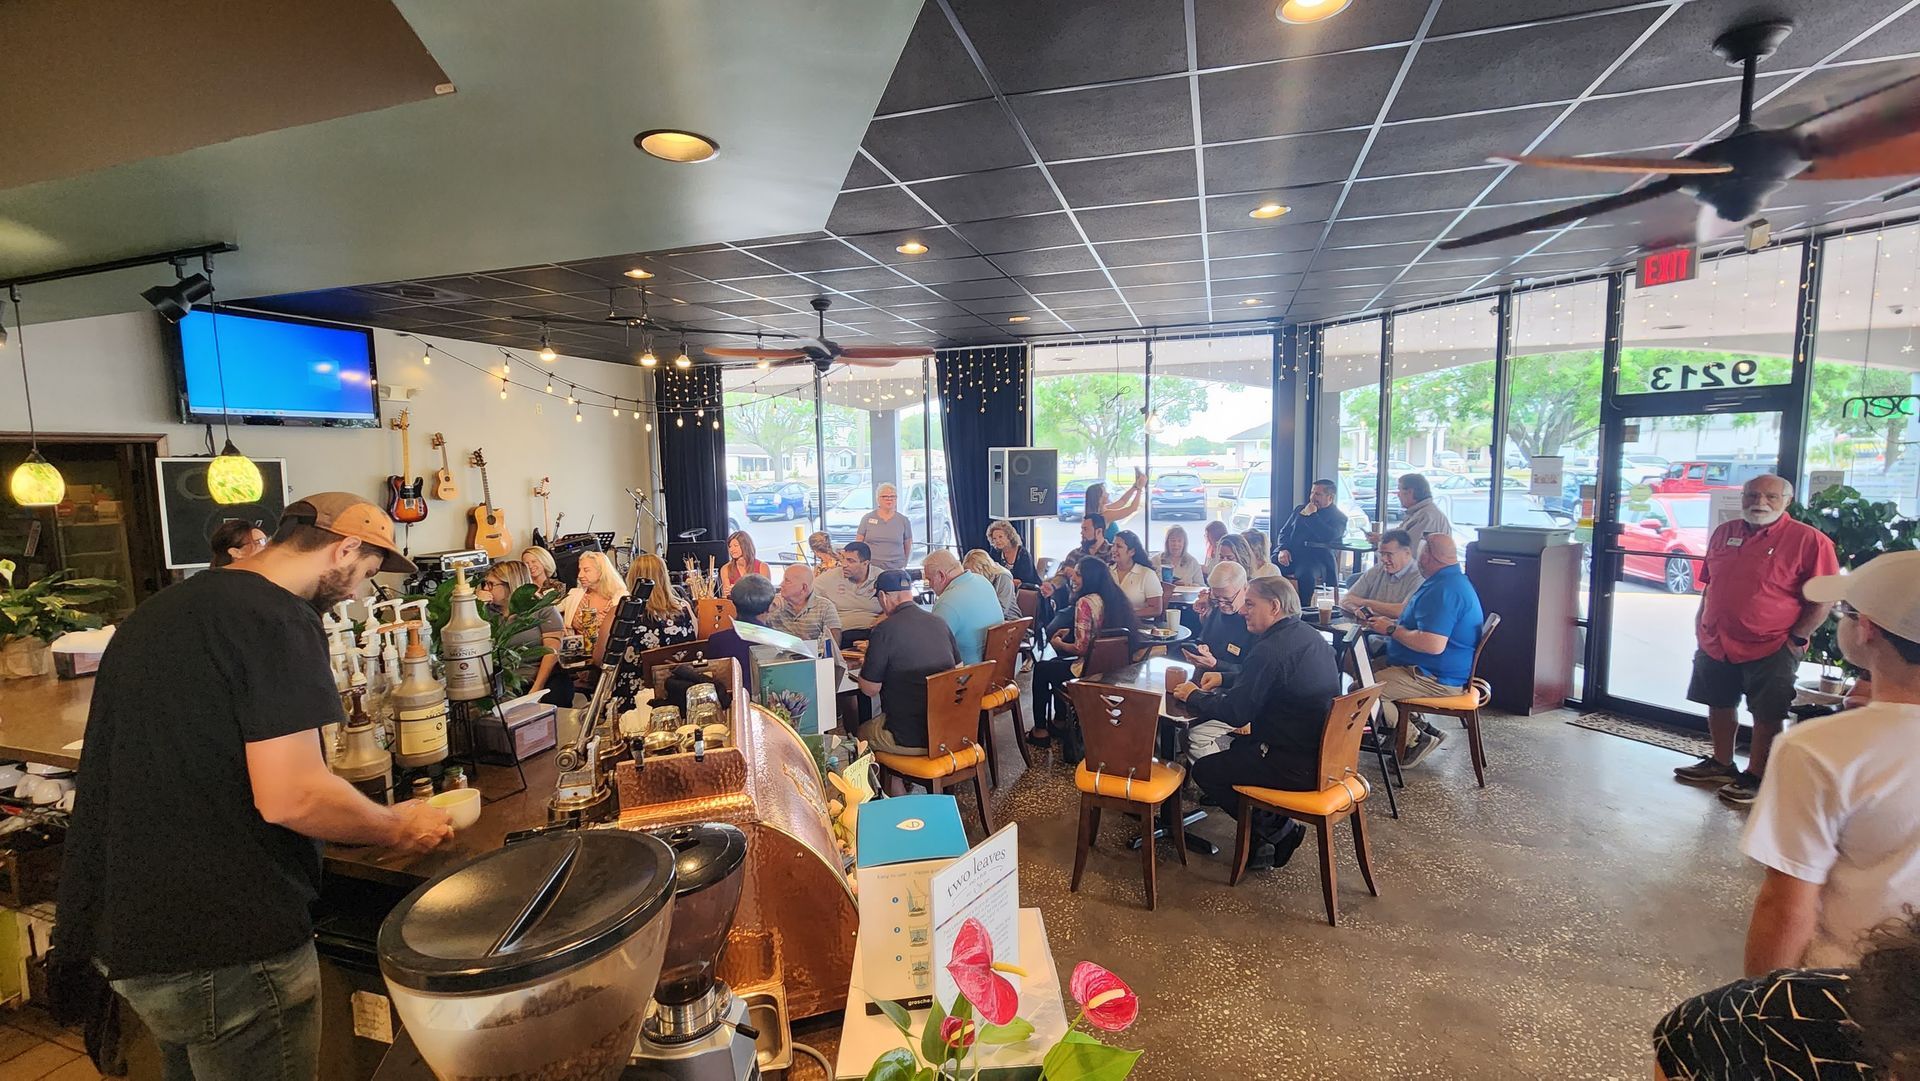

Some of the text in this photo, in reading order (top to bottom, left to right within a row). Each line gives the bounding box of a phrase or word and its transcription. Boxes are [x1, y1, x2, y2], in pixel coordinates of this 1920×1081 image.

[1644, 249, 1690, 286] EXIT
[947, 870, 971, 897] two
[973, 849, 1006, 874] leaves
